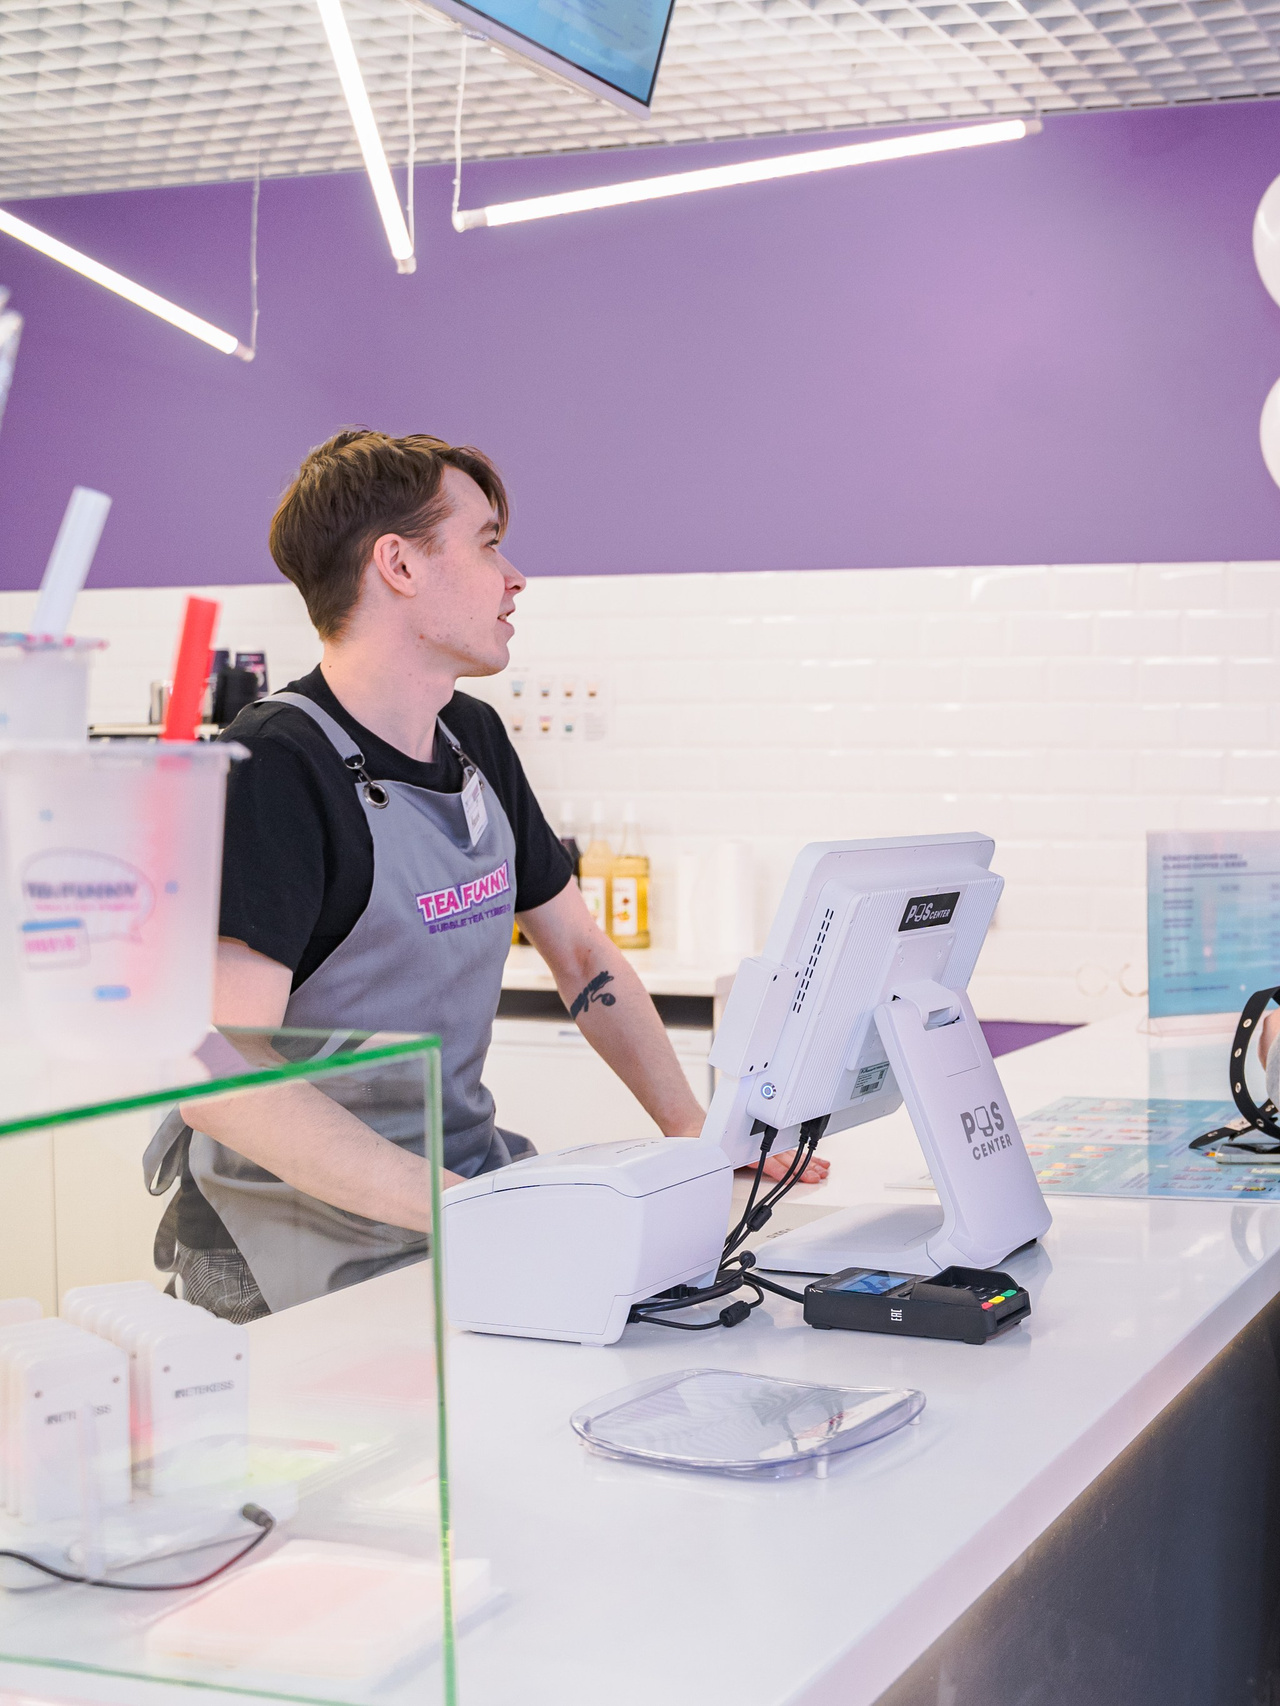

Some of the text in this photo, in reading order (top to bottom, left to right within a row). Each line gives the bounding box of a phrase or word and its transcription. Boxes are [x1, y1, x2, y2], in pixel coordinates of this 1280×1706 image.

[417, 862, 509, 921] TEA FUNNY
[467, 913, 484, 925] TEA
[930, 909, 951, 920] CENTER
[972, 1133, 1013, 1161] CENTER
